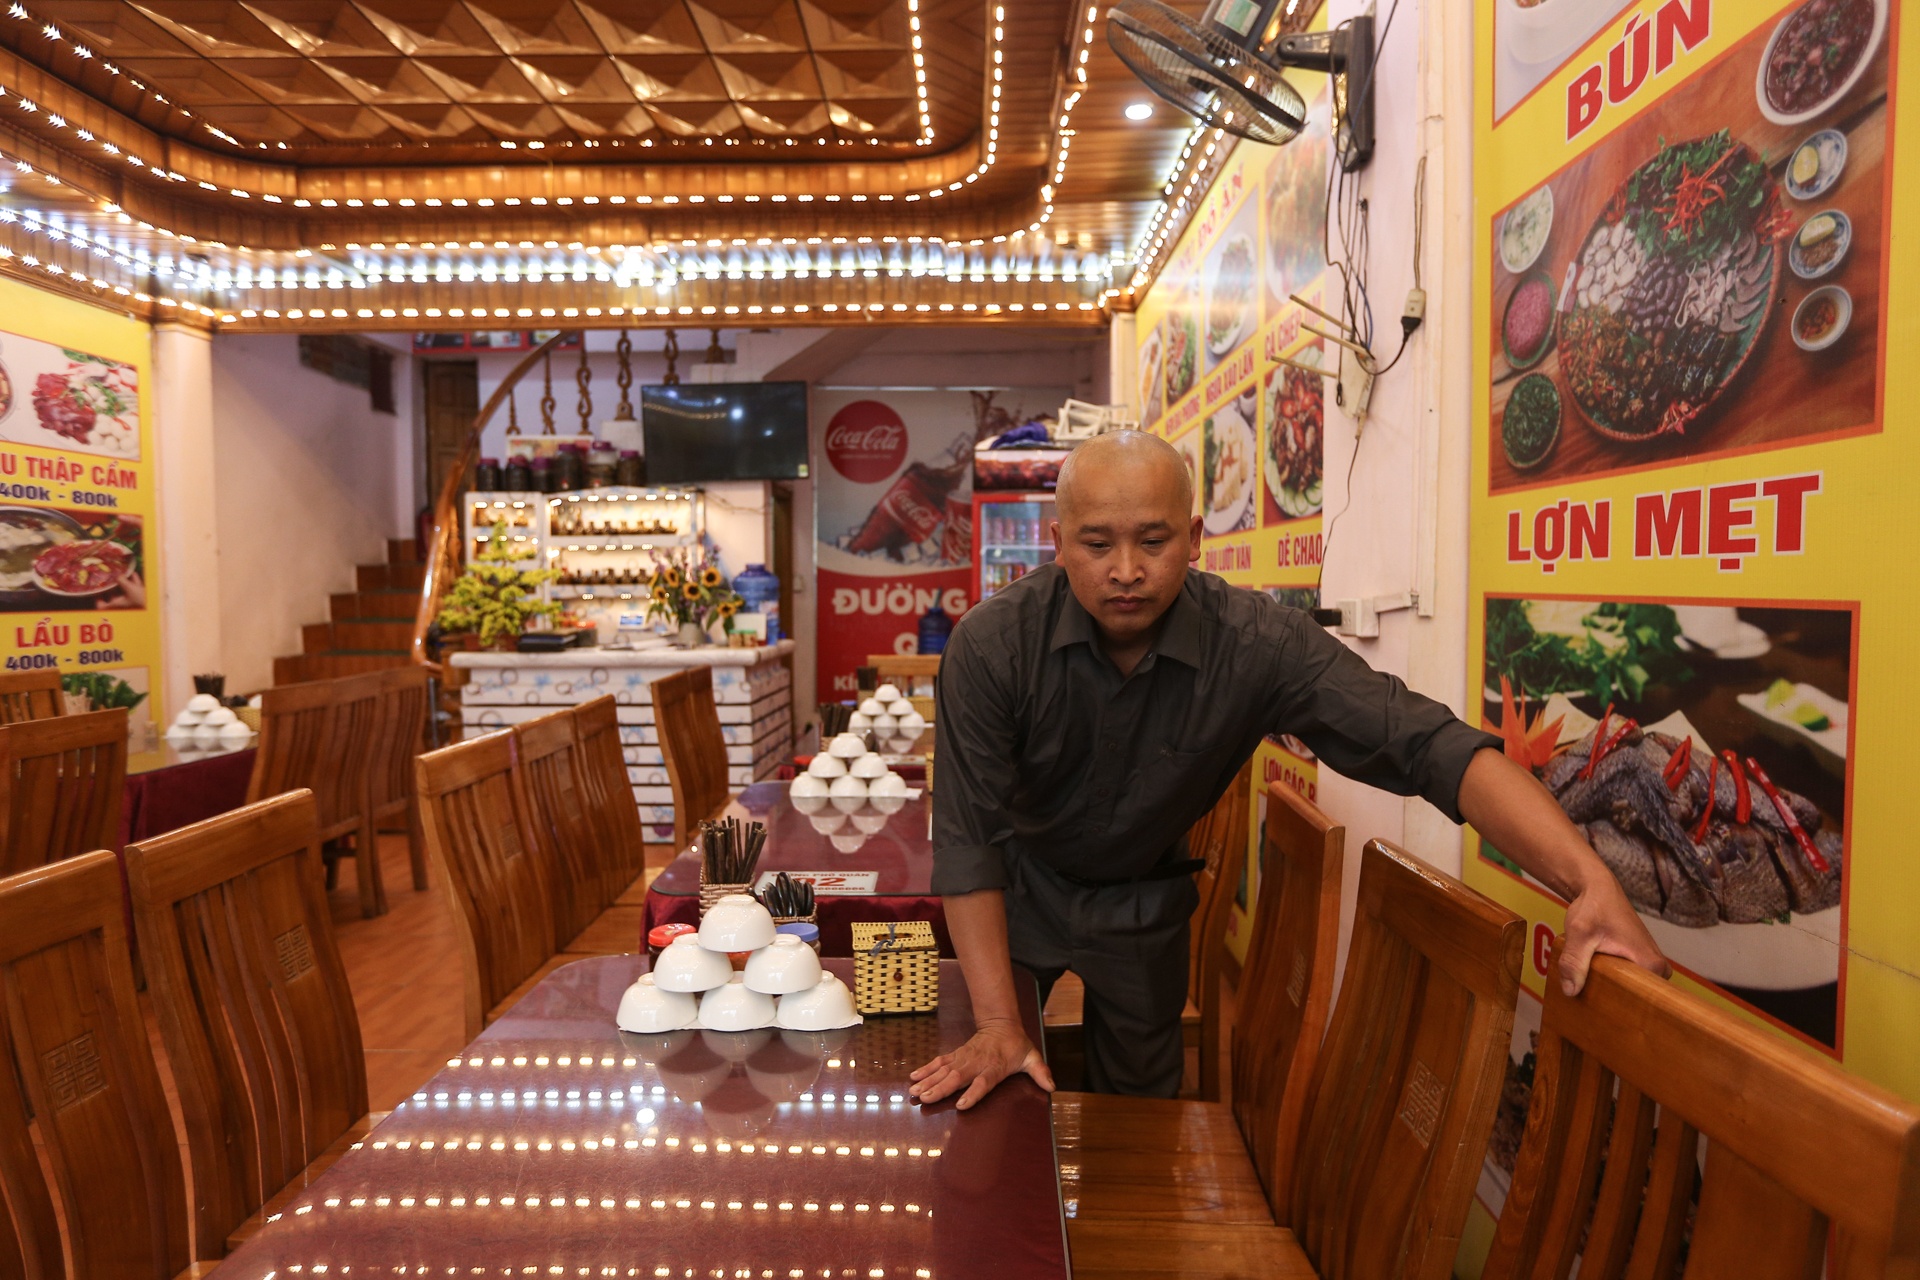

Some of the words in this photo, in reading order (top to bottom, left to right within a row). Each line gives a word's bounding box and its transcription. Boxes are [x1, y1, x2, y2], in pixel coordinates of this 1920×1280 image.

[1566, 0, 1711, 141] BÚN
[0, 452, 17, 475] U
[25, 456, 84, 486] THẬP
[0, 482, 51, 501] 400k
[72, 490, 118, 507] 800k
[1507, 499, 1611, 573] LỢN
[1633, 473, 1821, 571] MẸT
[1294, 533, 1322, 567] CHAO
[832, 584, 968, 615] ĐƯỜNG
[16, 617, 70, 648] LẨU
[80, 618, 113, 644] BÒ
[893, 632, 918, 655] Q
[6, 653, 58, 671] 400k
[79, 649, 124, 665] 800k
